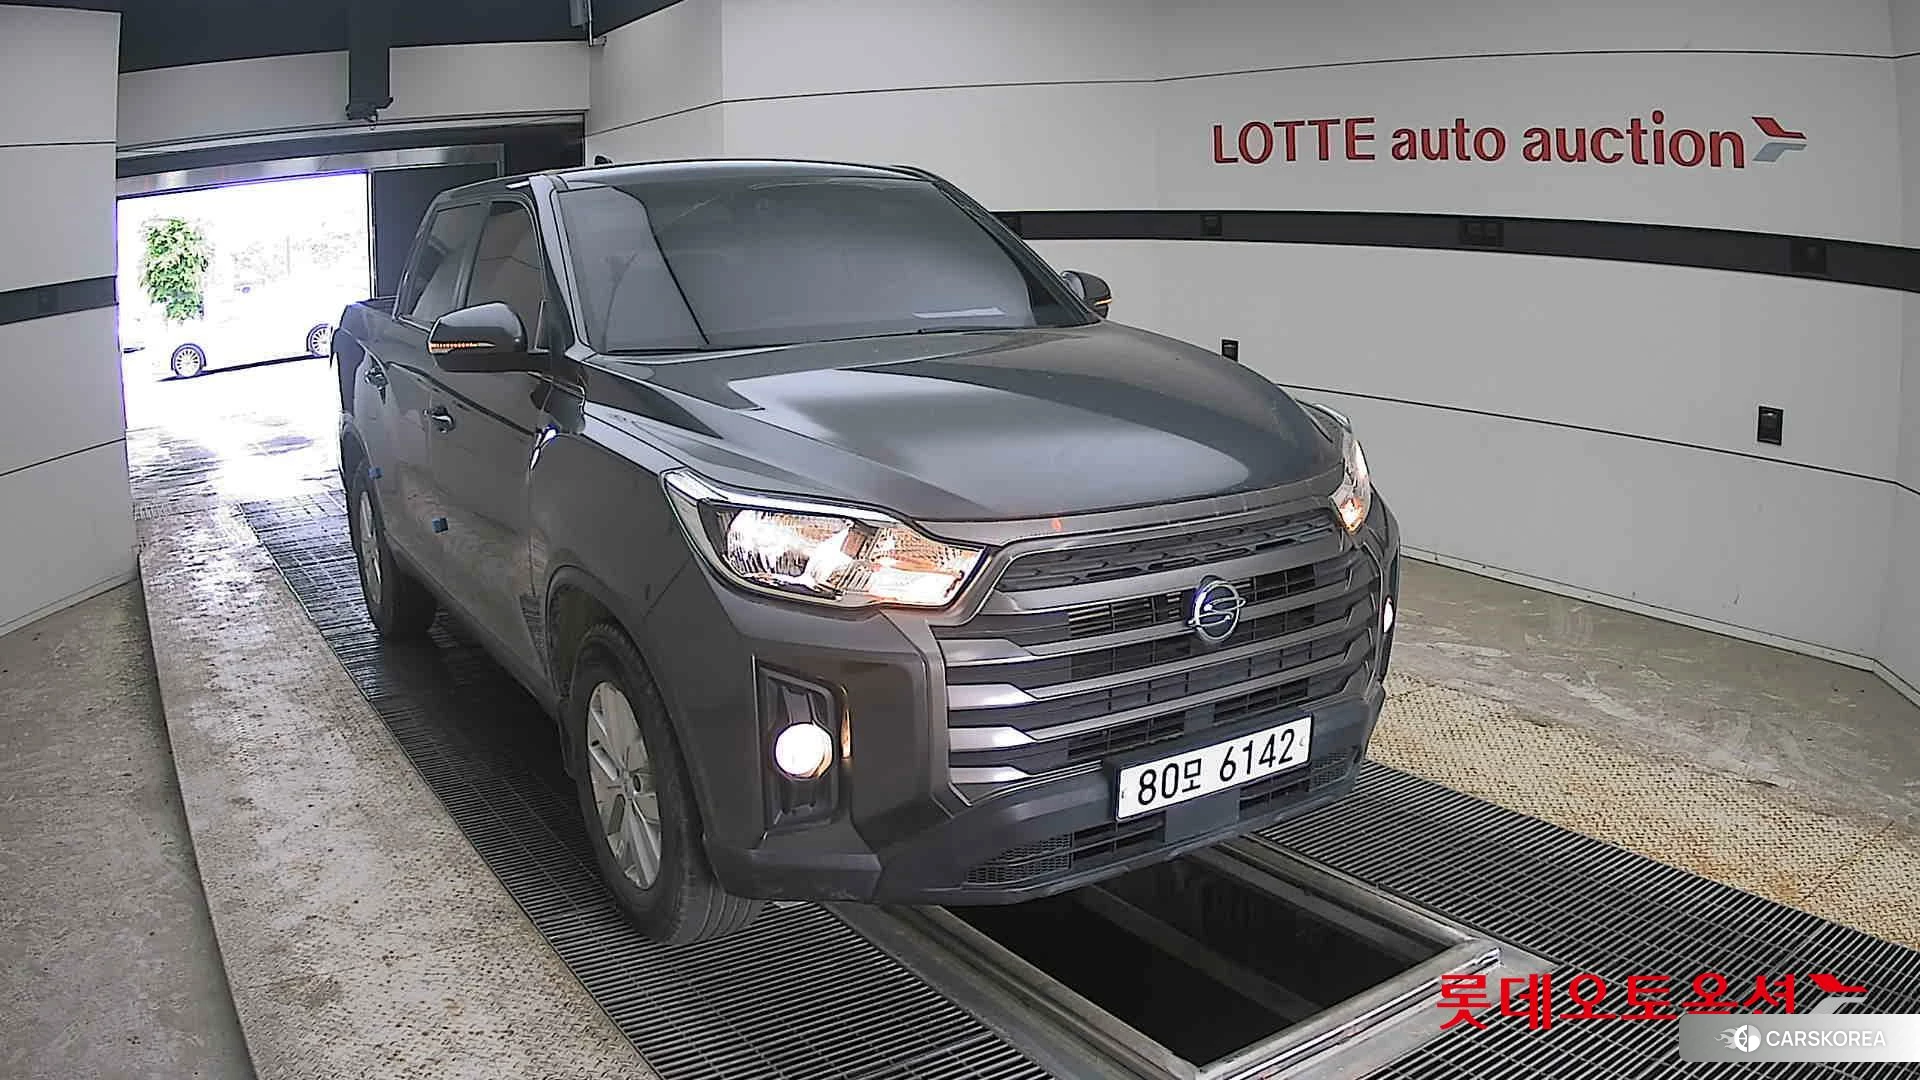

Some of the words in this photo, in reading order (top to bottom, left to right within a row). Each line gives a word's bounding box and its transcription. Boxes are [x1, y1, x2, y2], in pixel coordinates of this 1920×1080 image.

[1212, 117, 1376, 164] LOTTE
[1391, 118, 1506, 162] auto
[1521, 111, 1746, 169] auction
[1137, 758, 1202, 806] 80모
[1219, 728, 1295, 782] 6142
